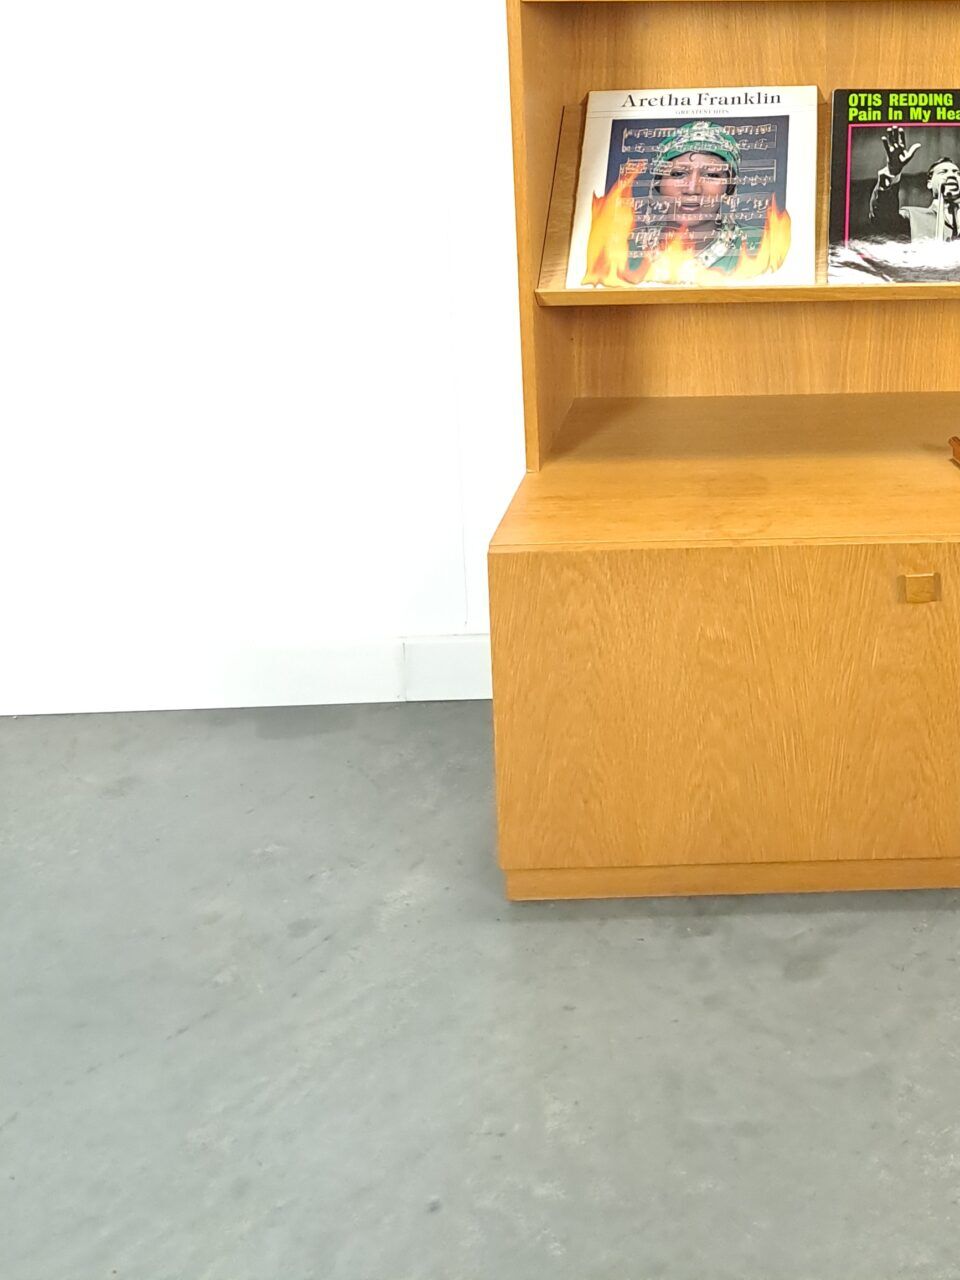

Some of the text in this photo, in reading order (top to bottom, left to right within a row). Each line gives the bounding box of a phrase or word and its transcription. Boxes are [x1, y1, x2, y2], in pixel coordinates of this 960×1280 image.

[621, 91, 782, 108] Aretha Franklin
[848, 93, 954, 107] OTIS REDDING
[848, 107, 882, 121] Pain
[888, 107, 903, 121] In
[909, 107, 931, 123] My
